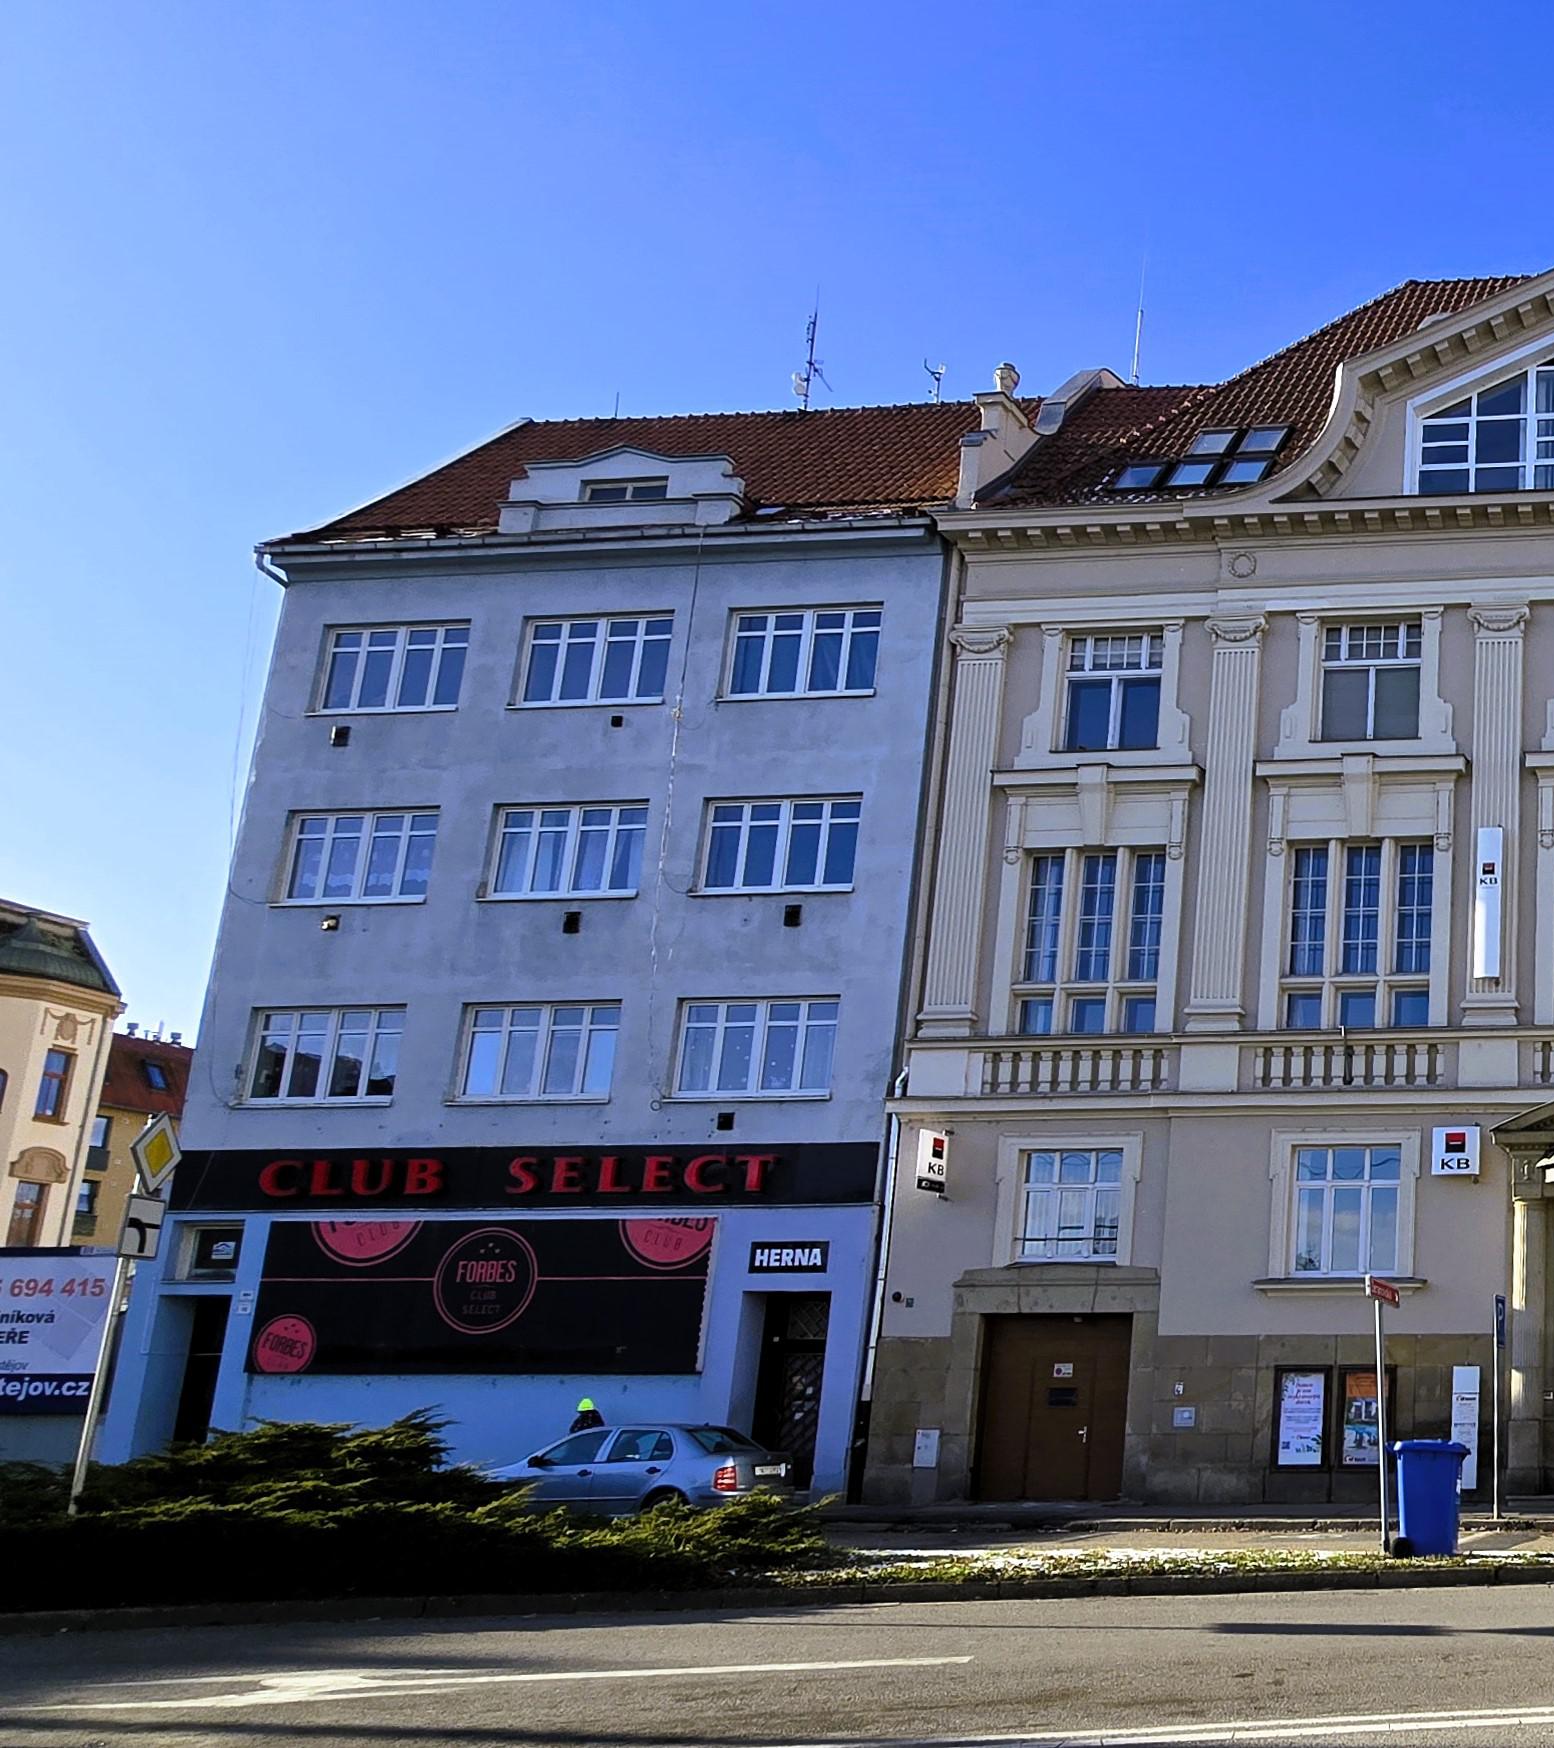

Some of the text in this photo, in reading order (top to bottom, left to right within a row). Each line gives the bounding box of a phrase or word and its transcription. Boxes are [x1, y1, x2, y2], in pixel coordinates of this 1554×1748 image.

[1480, 877, 1497, 885] KB
[928, 1162, 944, 1176] KB
[1440, 1158, 1470, 1170] KB
[258, 1154, 778, 1196] CLUB SELECT
[643, 1229, 683, 1251] CLUB
[754, 1248, 822, 1267] HERNA
[455, 1260, 517, 1283] FORBES
[10, 1279, 54, 1297] 694
[60, 1278, 106, 1297] 415
[470, 1290, 497, 1300] CLUB
[461, 1304, 501, 1315] SELECT
[261, 1332, 309, 1360] FORBES
